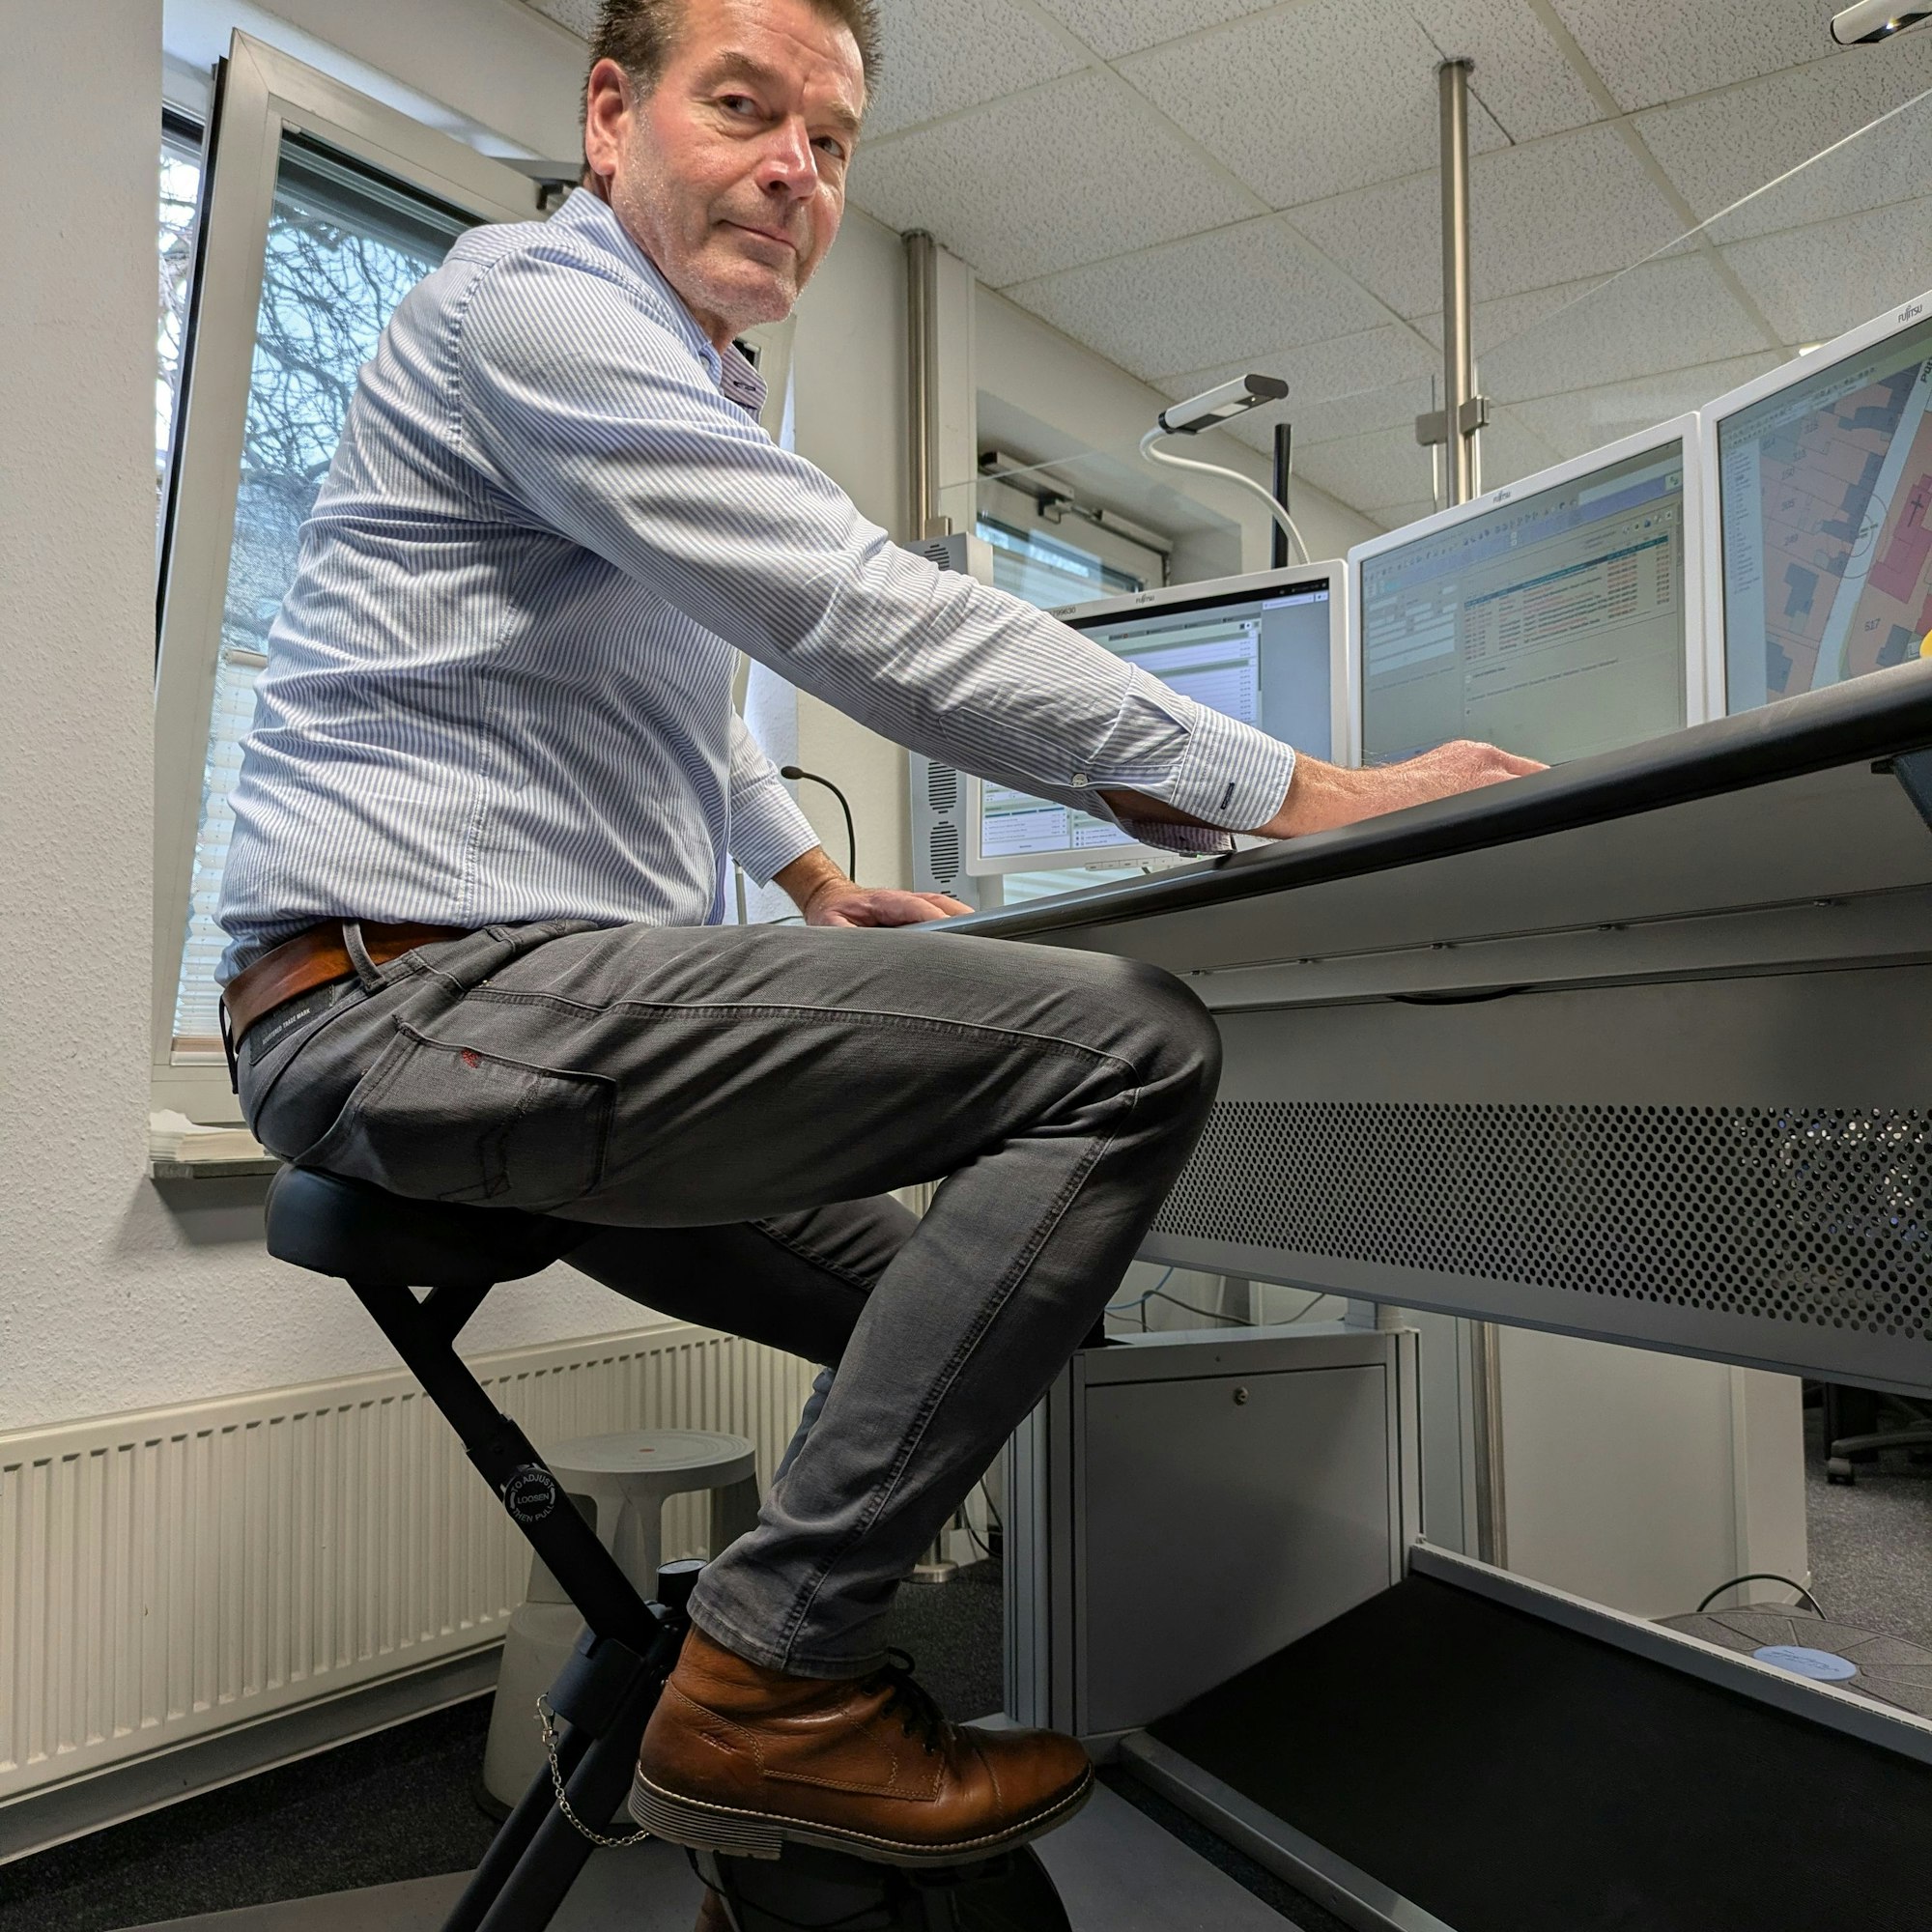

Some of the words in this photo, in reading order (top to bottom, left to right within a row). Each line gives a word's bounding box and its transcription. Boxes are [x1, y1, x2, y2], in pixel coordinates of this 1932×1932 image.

[1897, 304, 1923, 323] FUJITSU
[297, 1009, 310, 1020] MARK
[511, 1481, 523, 1492] TO
[524, 1474, 555, 1489] ADJUST
[518, 1492, 549, 1504] LOOSEN
[513, 1508, 533, 1522] THEN
[535, 1505, 554, 1520] PULL
